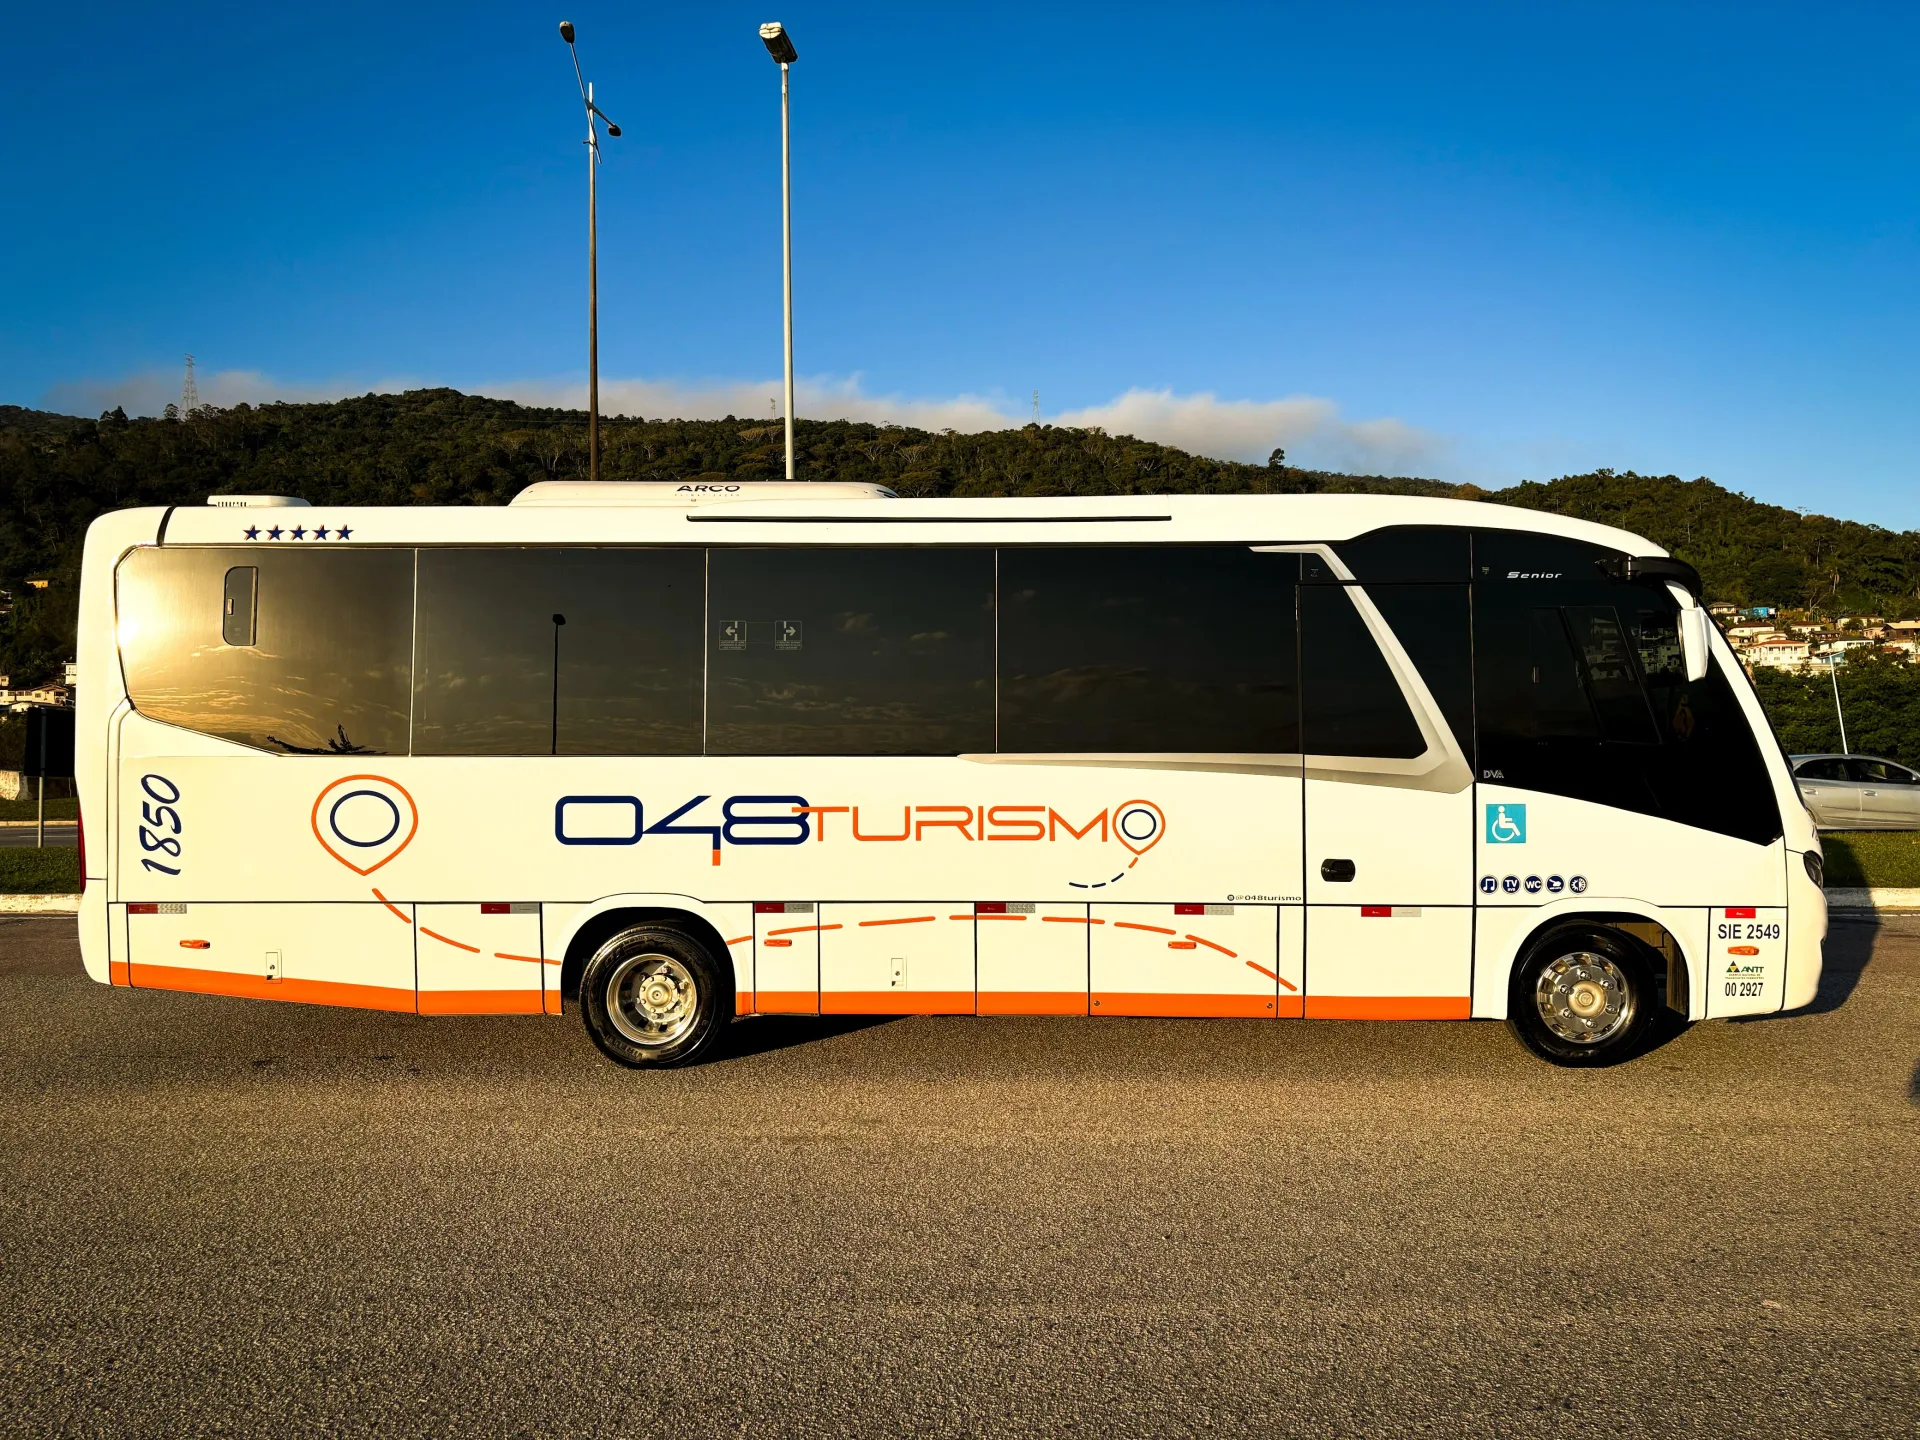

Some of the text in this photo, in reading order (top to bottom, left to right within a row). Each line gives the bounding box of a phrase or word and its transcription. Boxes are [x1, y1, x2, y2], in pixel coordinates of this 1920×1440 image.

[1507, 571, 1562, 579] Senior
[1483, 769, 1504, 779] DVA
[139, 774, 182, 875] 1850
[1505, 879, 1517, 888] TV
[1525, 880, 1541, 889] WC
[1718, 924, 1780, 939] SIE 2549
[1725, 982, 1764, 997] 00 2927
